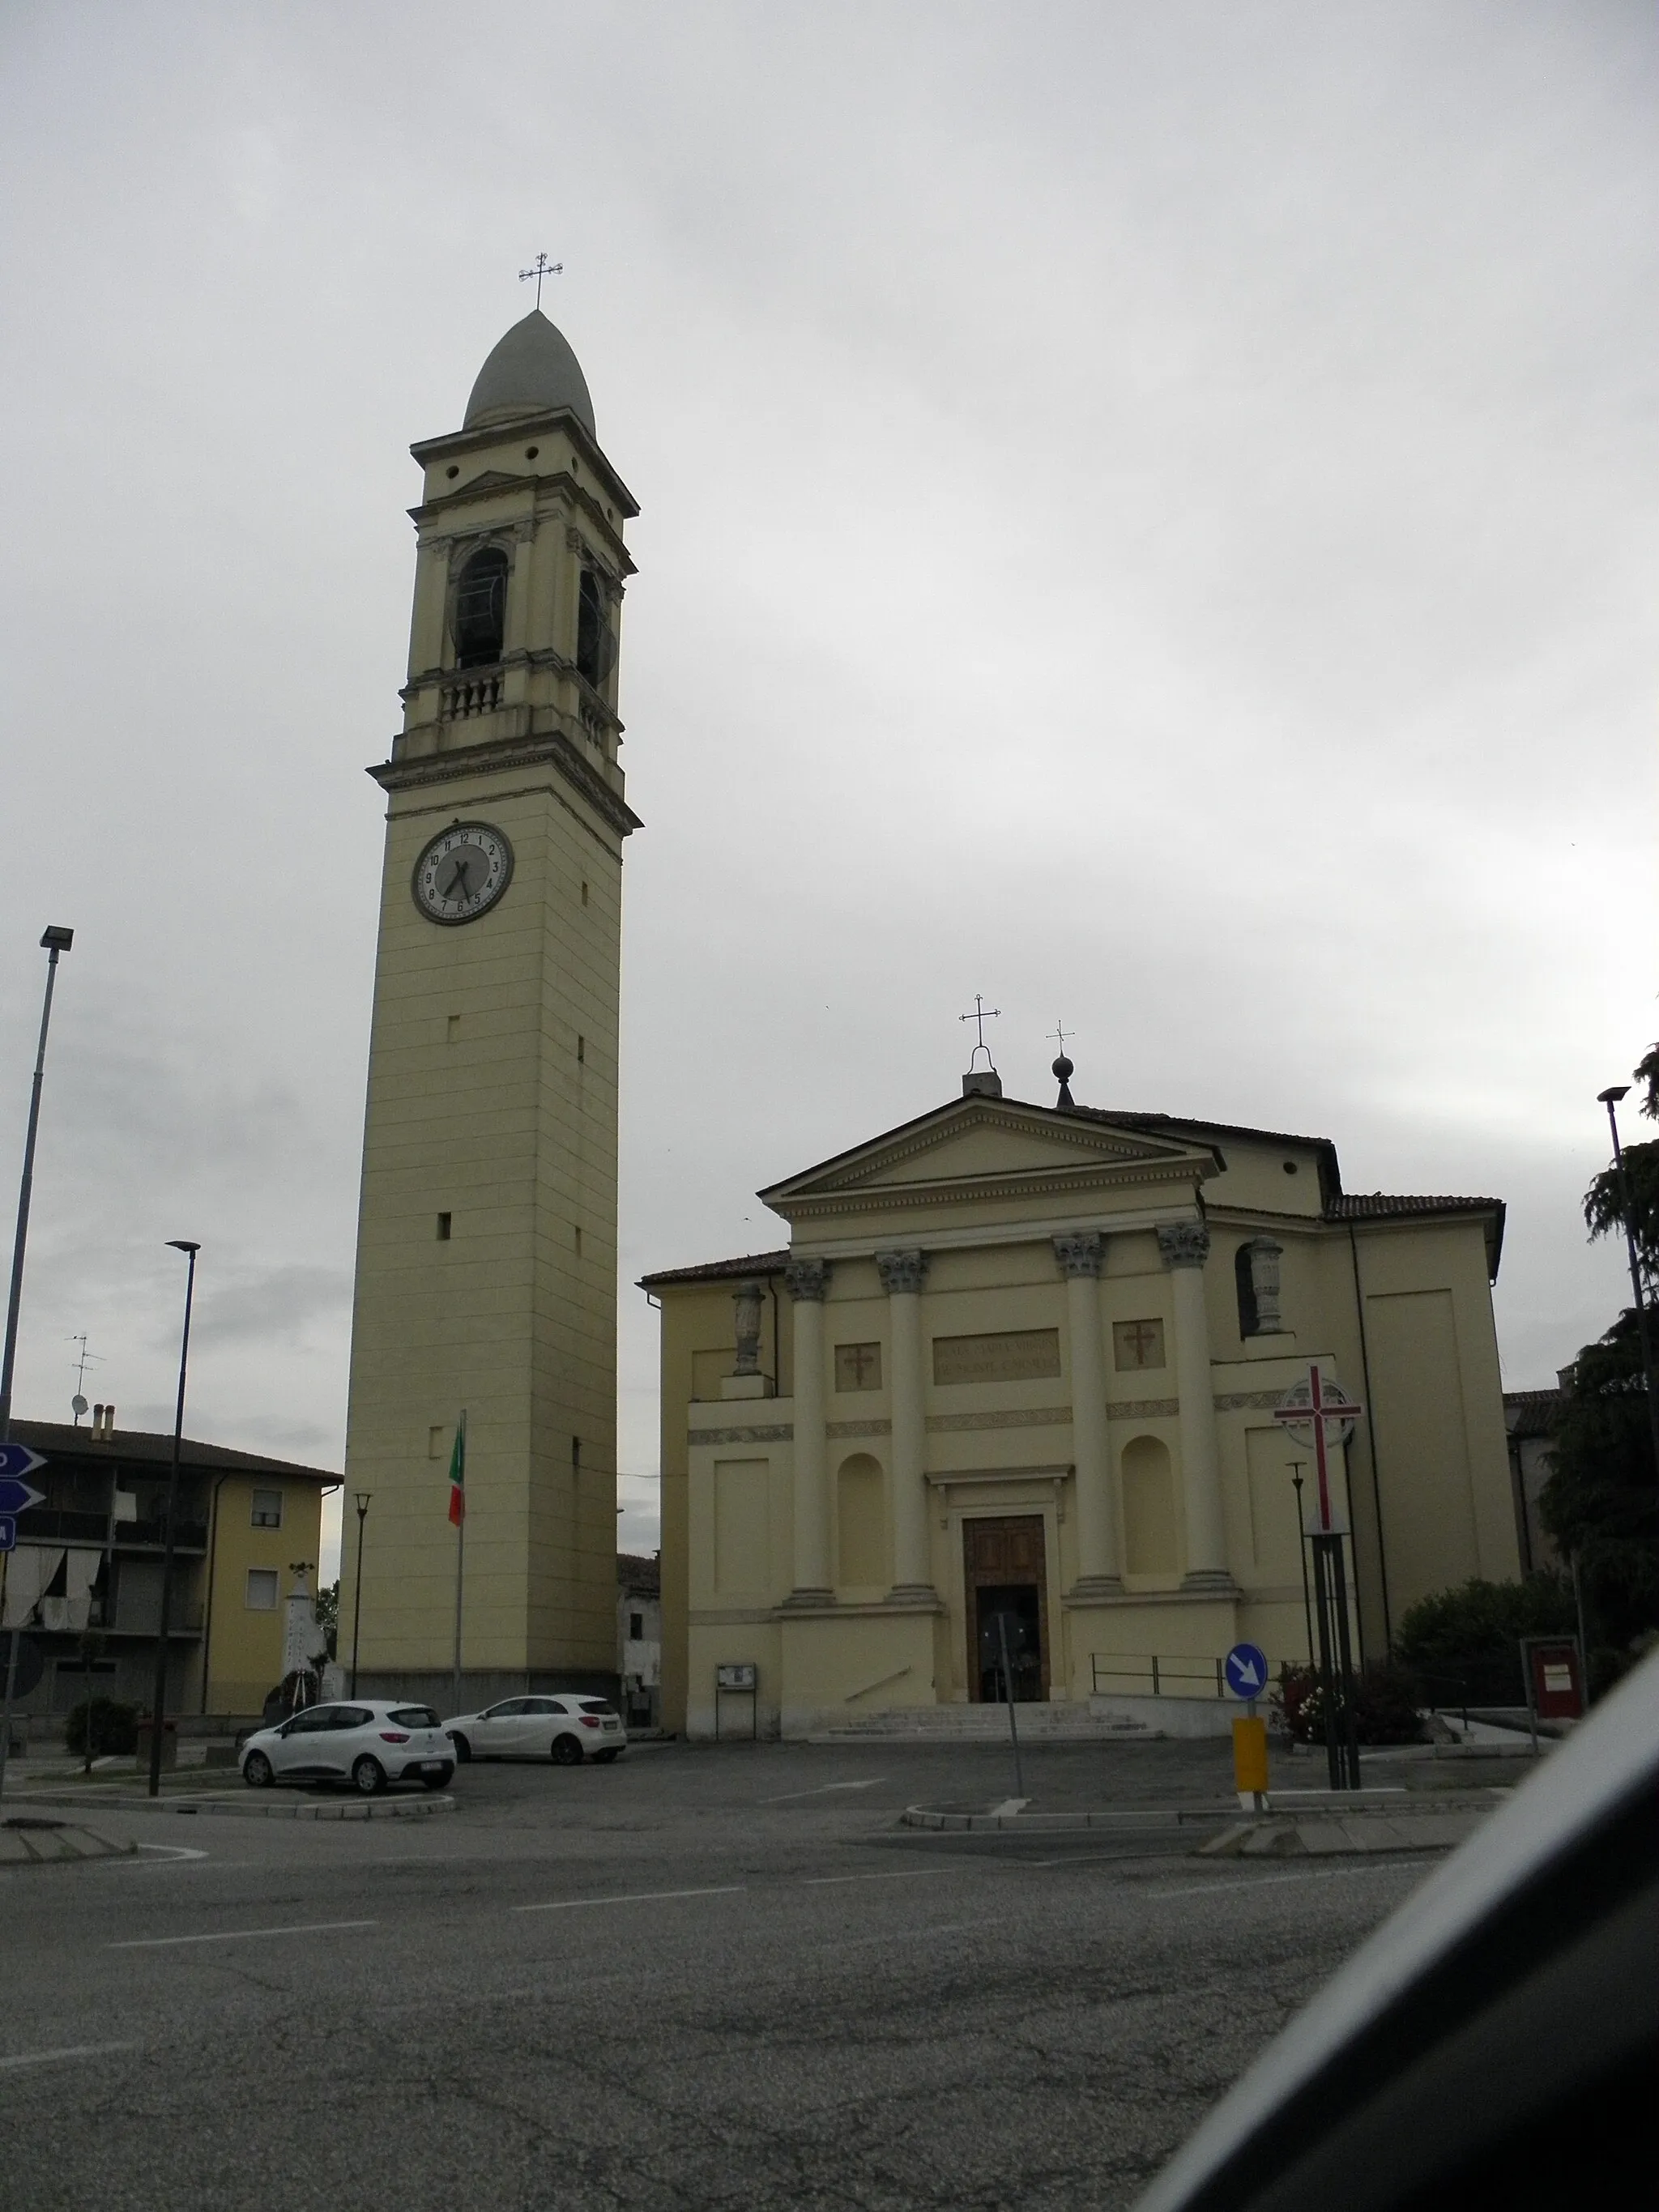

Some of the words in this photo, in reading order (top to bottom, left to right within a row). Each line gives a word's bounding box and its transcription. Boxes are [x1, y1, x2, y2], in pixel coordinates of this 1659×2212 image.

[460, 833, 469, 844] 12
[445, 841, 451, 851] 11
[488, 845, 495, 855] 2
[430, 855, 439, 866] 10
[493, 862, 499, 872] 3
[426, 873, 432, 884] 9
[486, 878, 493, 889] 4
[429, 889, 434, 900] 8
[475, 893, 480, 904] 5
[441, 900, 446, 911] 7
[458, 901, 463, 911] 6
